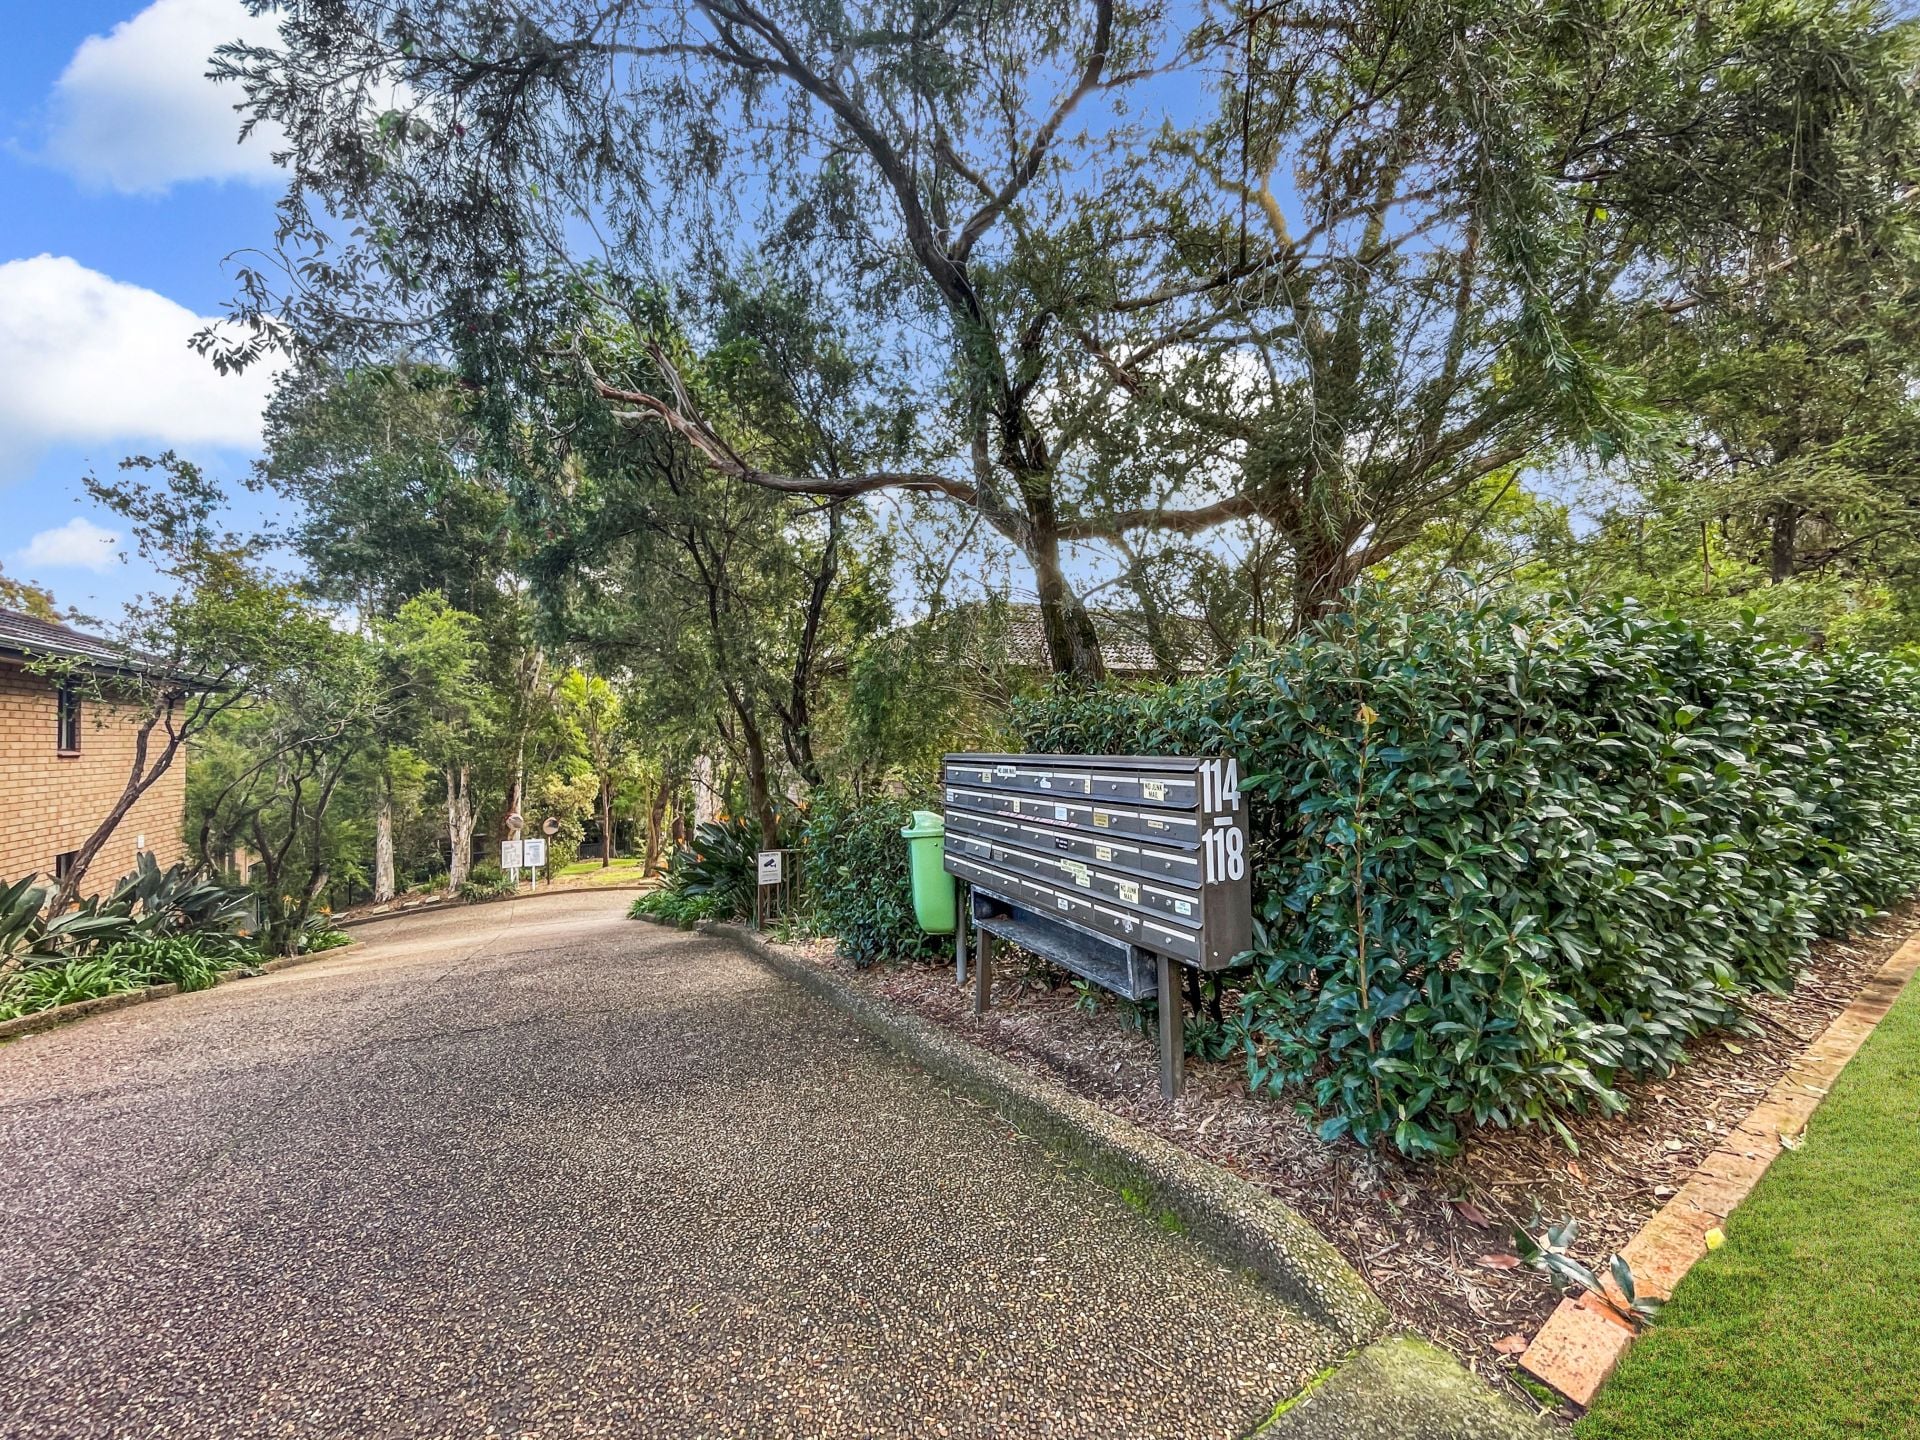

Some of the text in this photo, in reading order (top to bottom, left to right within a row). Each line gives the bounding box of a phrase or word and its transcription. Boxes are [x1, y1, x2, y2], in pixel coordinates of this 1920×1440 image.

[1144, 782, 1163, 792] NO JUNK
[1199, 758, 1241, 813] 114
[1148, 790, 1159, 799] MAIL
[1201, 826, 1244, 882] 118
[1127, 886, 1137, 894] JUNK
[1124, 893, 1133, 901] MAIL
